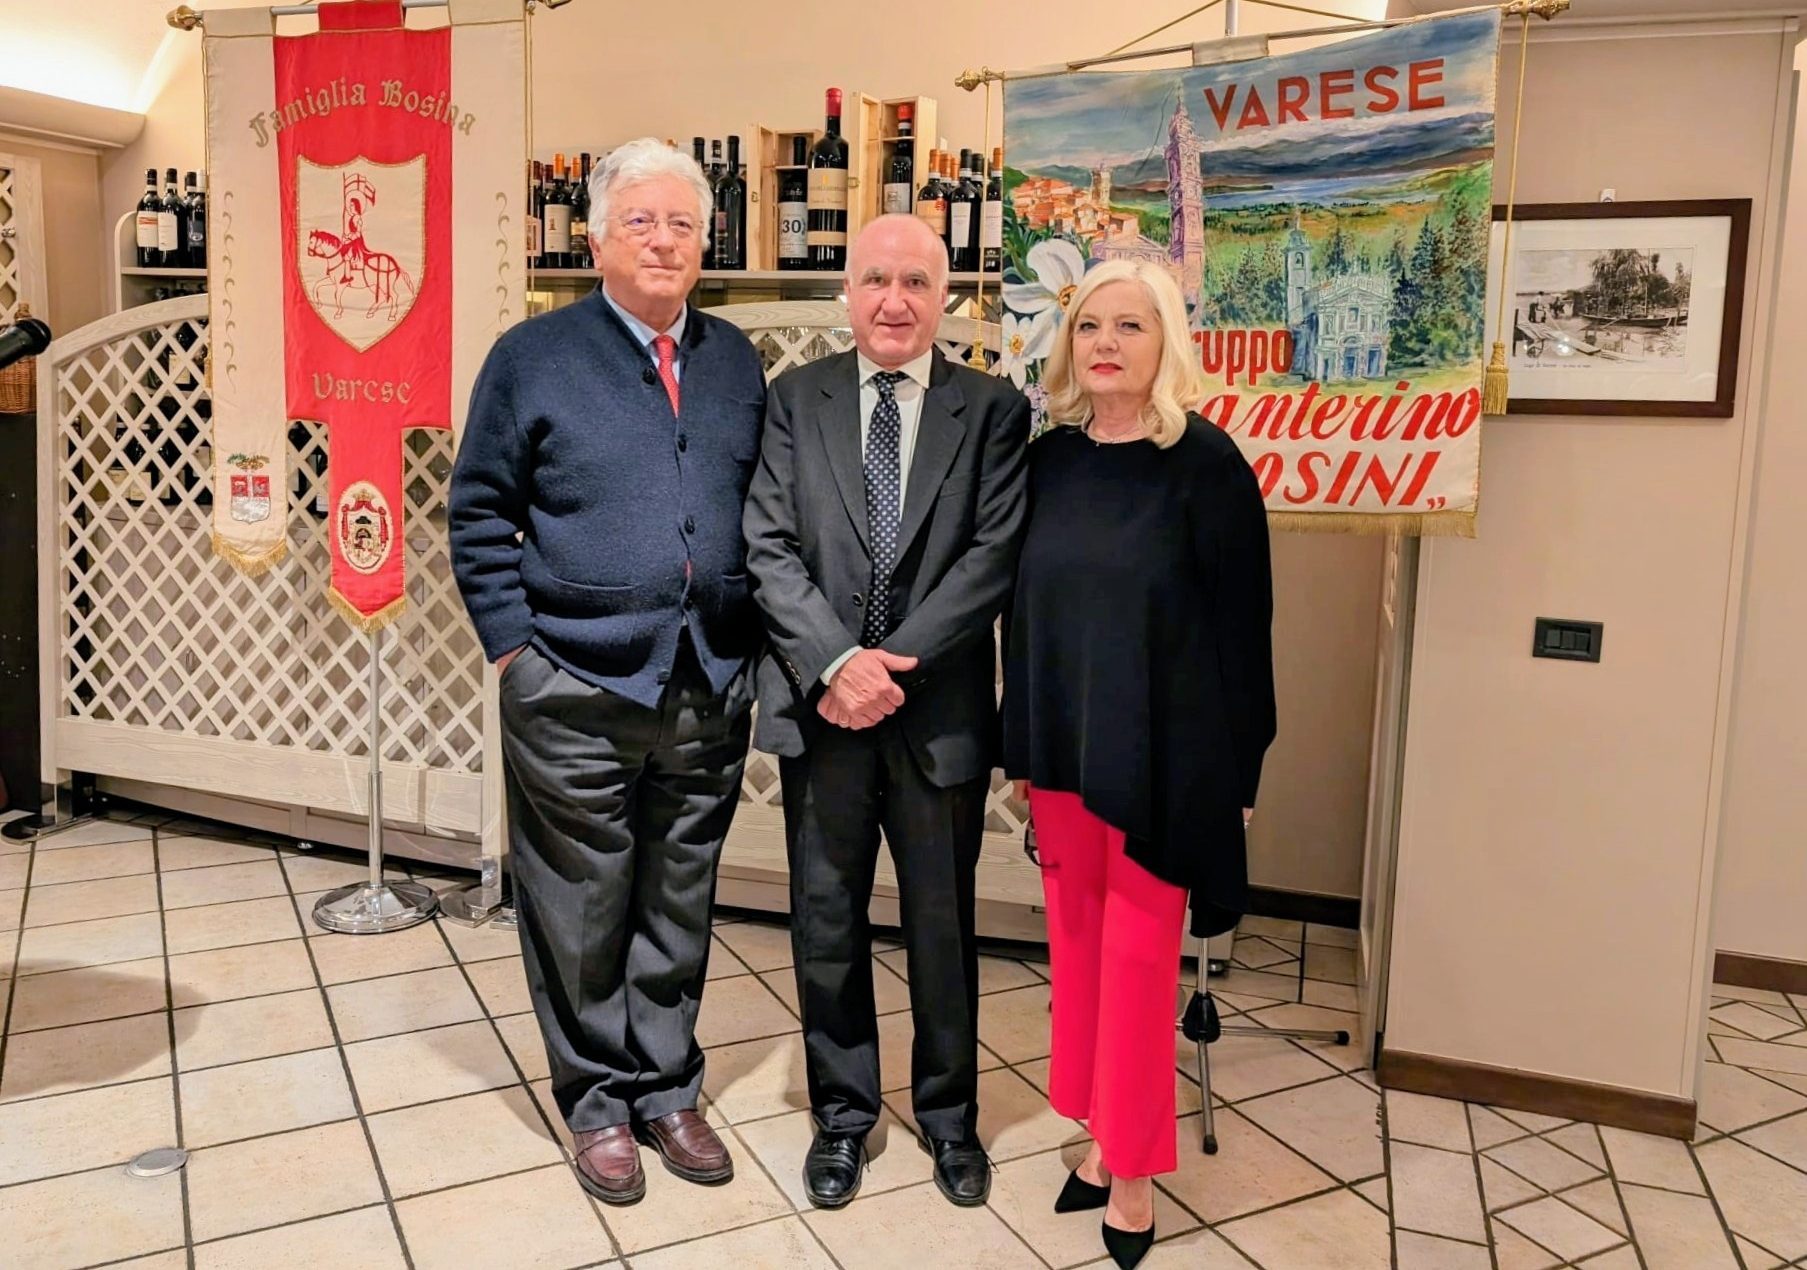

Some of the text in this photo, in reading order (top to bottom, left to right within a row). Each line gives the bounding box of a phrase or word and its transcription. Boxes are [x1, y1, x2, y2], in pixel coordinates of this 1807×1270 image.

[249, 77, 477, 148] Famiglia Bosina
[1203, 58, 1445, 132] VARESE
[312, 371, 411, 404] Varese
[1192, 329, 1293, 386] uppo
[1200, 380, 1482, 441] anterino
